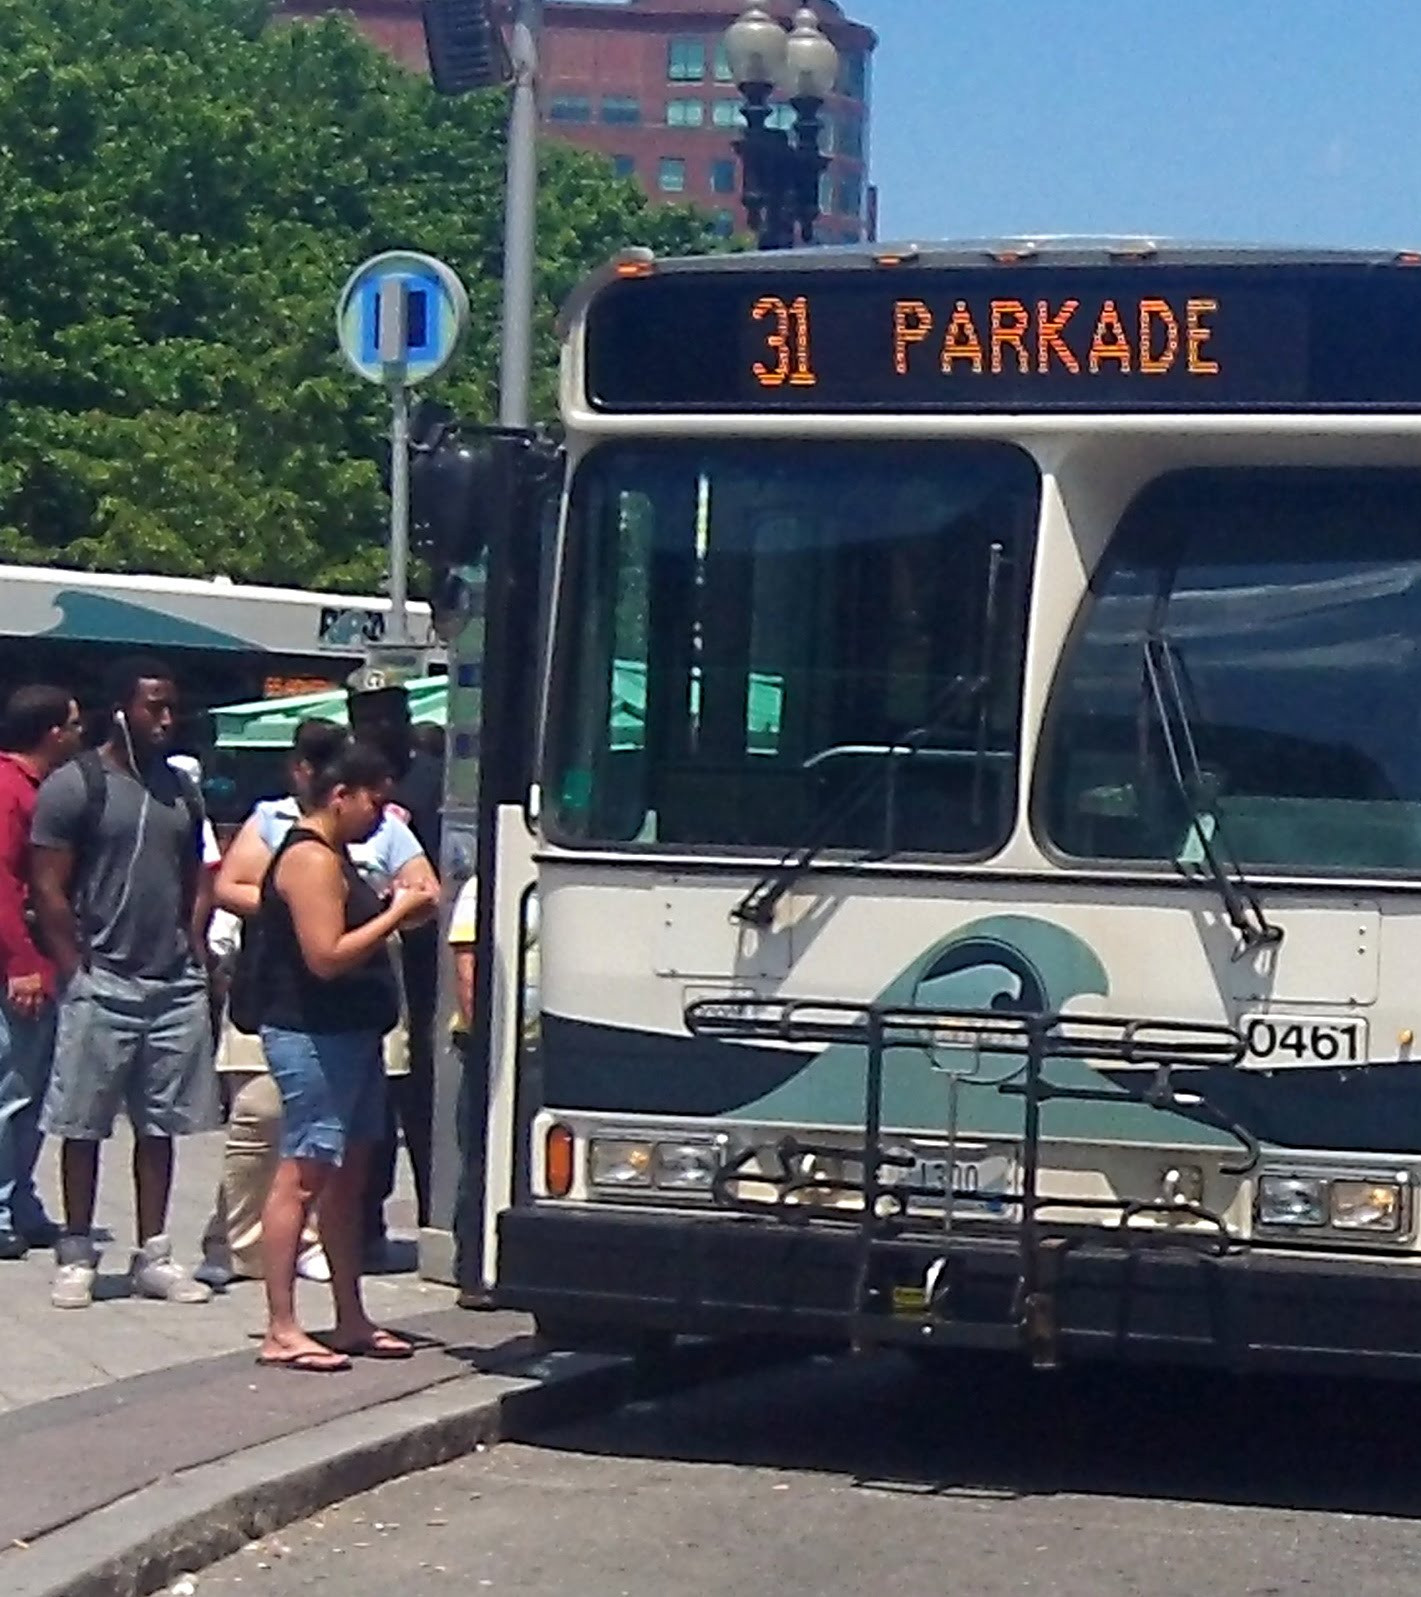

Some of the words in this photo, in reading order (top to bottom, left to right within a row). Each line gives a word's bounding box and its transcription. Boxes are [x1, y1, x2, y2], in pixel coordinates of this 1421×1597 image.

[752, 296, 817, 386] 31
[894, 299, 1221, 374] PARKADE
[1247, 1019, 1357, 1060] 0461
